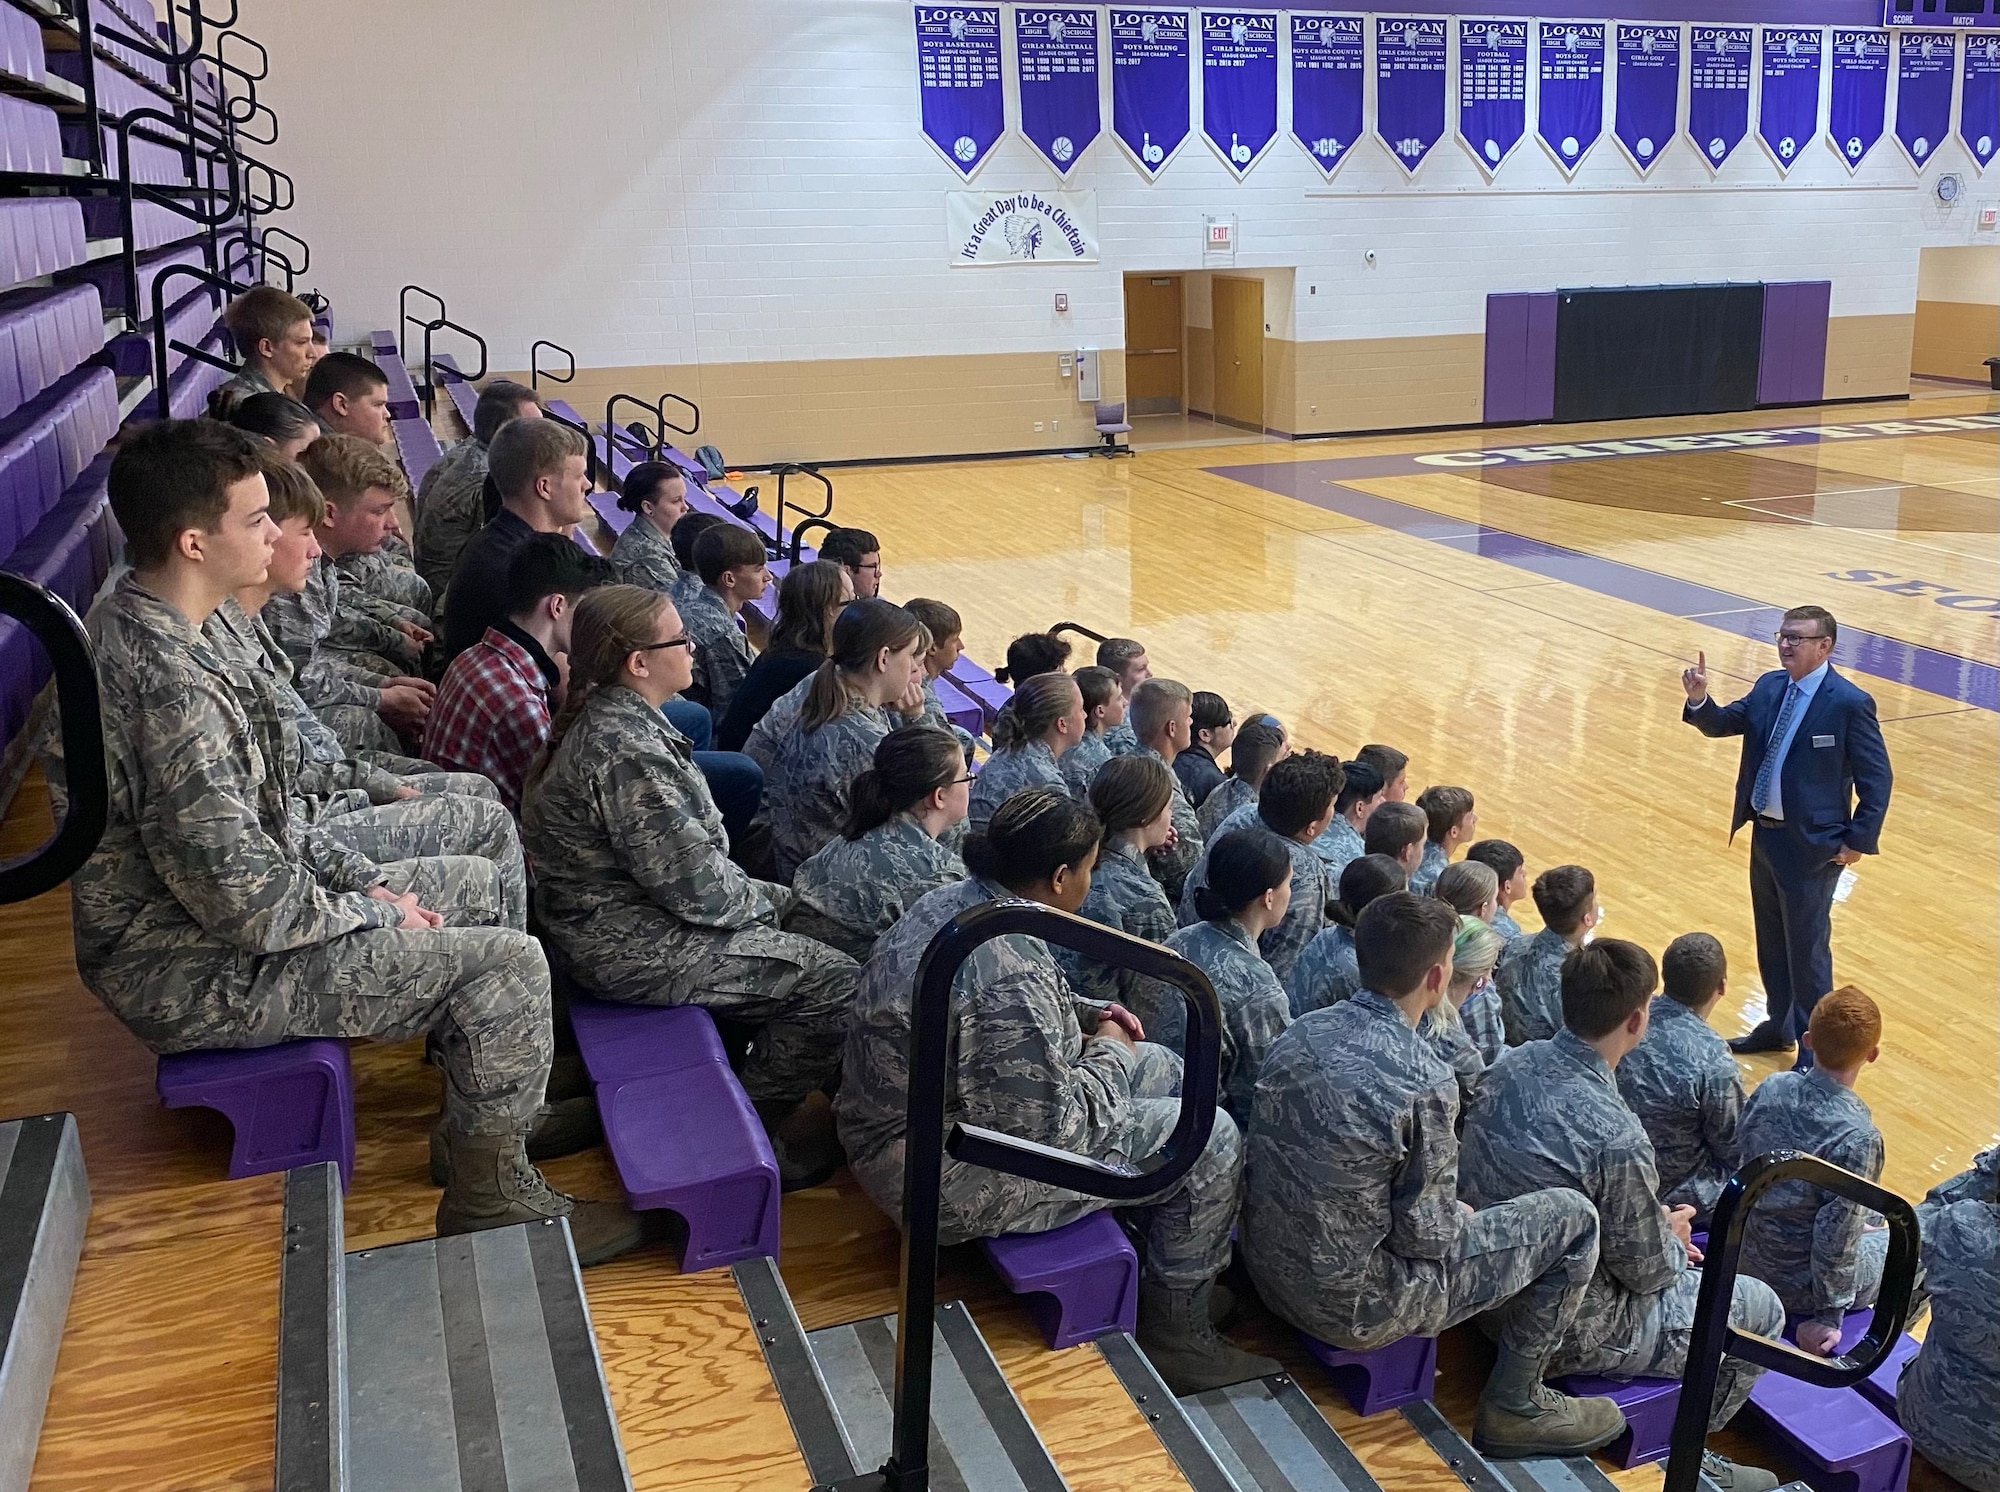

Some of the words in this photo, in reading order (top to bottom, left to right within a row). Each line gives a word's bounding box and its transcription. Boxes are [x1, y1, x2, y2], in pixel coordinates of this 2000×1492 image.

[919, 10, 997, 25] LOGAN
[1019, 12, 1094, 27] LOGAN
[1113, 14, 1186, 28] LOGAN
[1204, 16, 1274, 30] LOGAN
[1893, 15, 1914, 24] SCORE
[1953, 16, 1974, 25] MATCH
[1294, 19, 1361, 33] LOGAN
[1380, 22, 1444, 35] LOGAN
[1462, 24, 1525, 36] LOGAN
[1542, 26, 1603, 38] LOGAN
[1620, 28, 1678, 41] LOGAN
[1694, 30, 1750, 42] LOGAN
[1765, 32, 1820, 44] LOGAN
[1835, 33, 1888, 45] LOGAN
[1902, 35, 1954, 47] LOGAN
[995, 197, 1015, 214] Day
[1017, 194, 1028, 208] to
[1031, 194, 1044, 211] be
[1044, 204, 1051, 216] a
[1985, 211, 1996, 222] EXIT
[973, 207, 999, 235] Great
[1052, 208, 1086, 256] Chieftain
[1213, 227, 1228, 240] EXIT
[971, 234, 982, 244] a
[961, 242, 978, 259] It's
